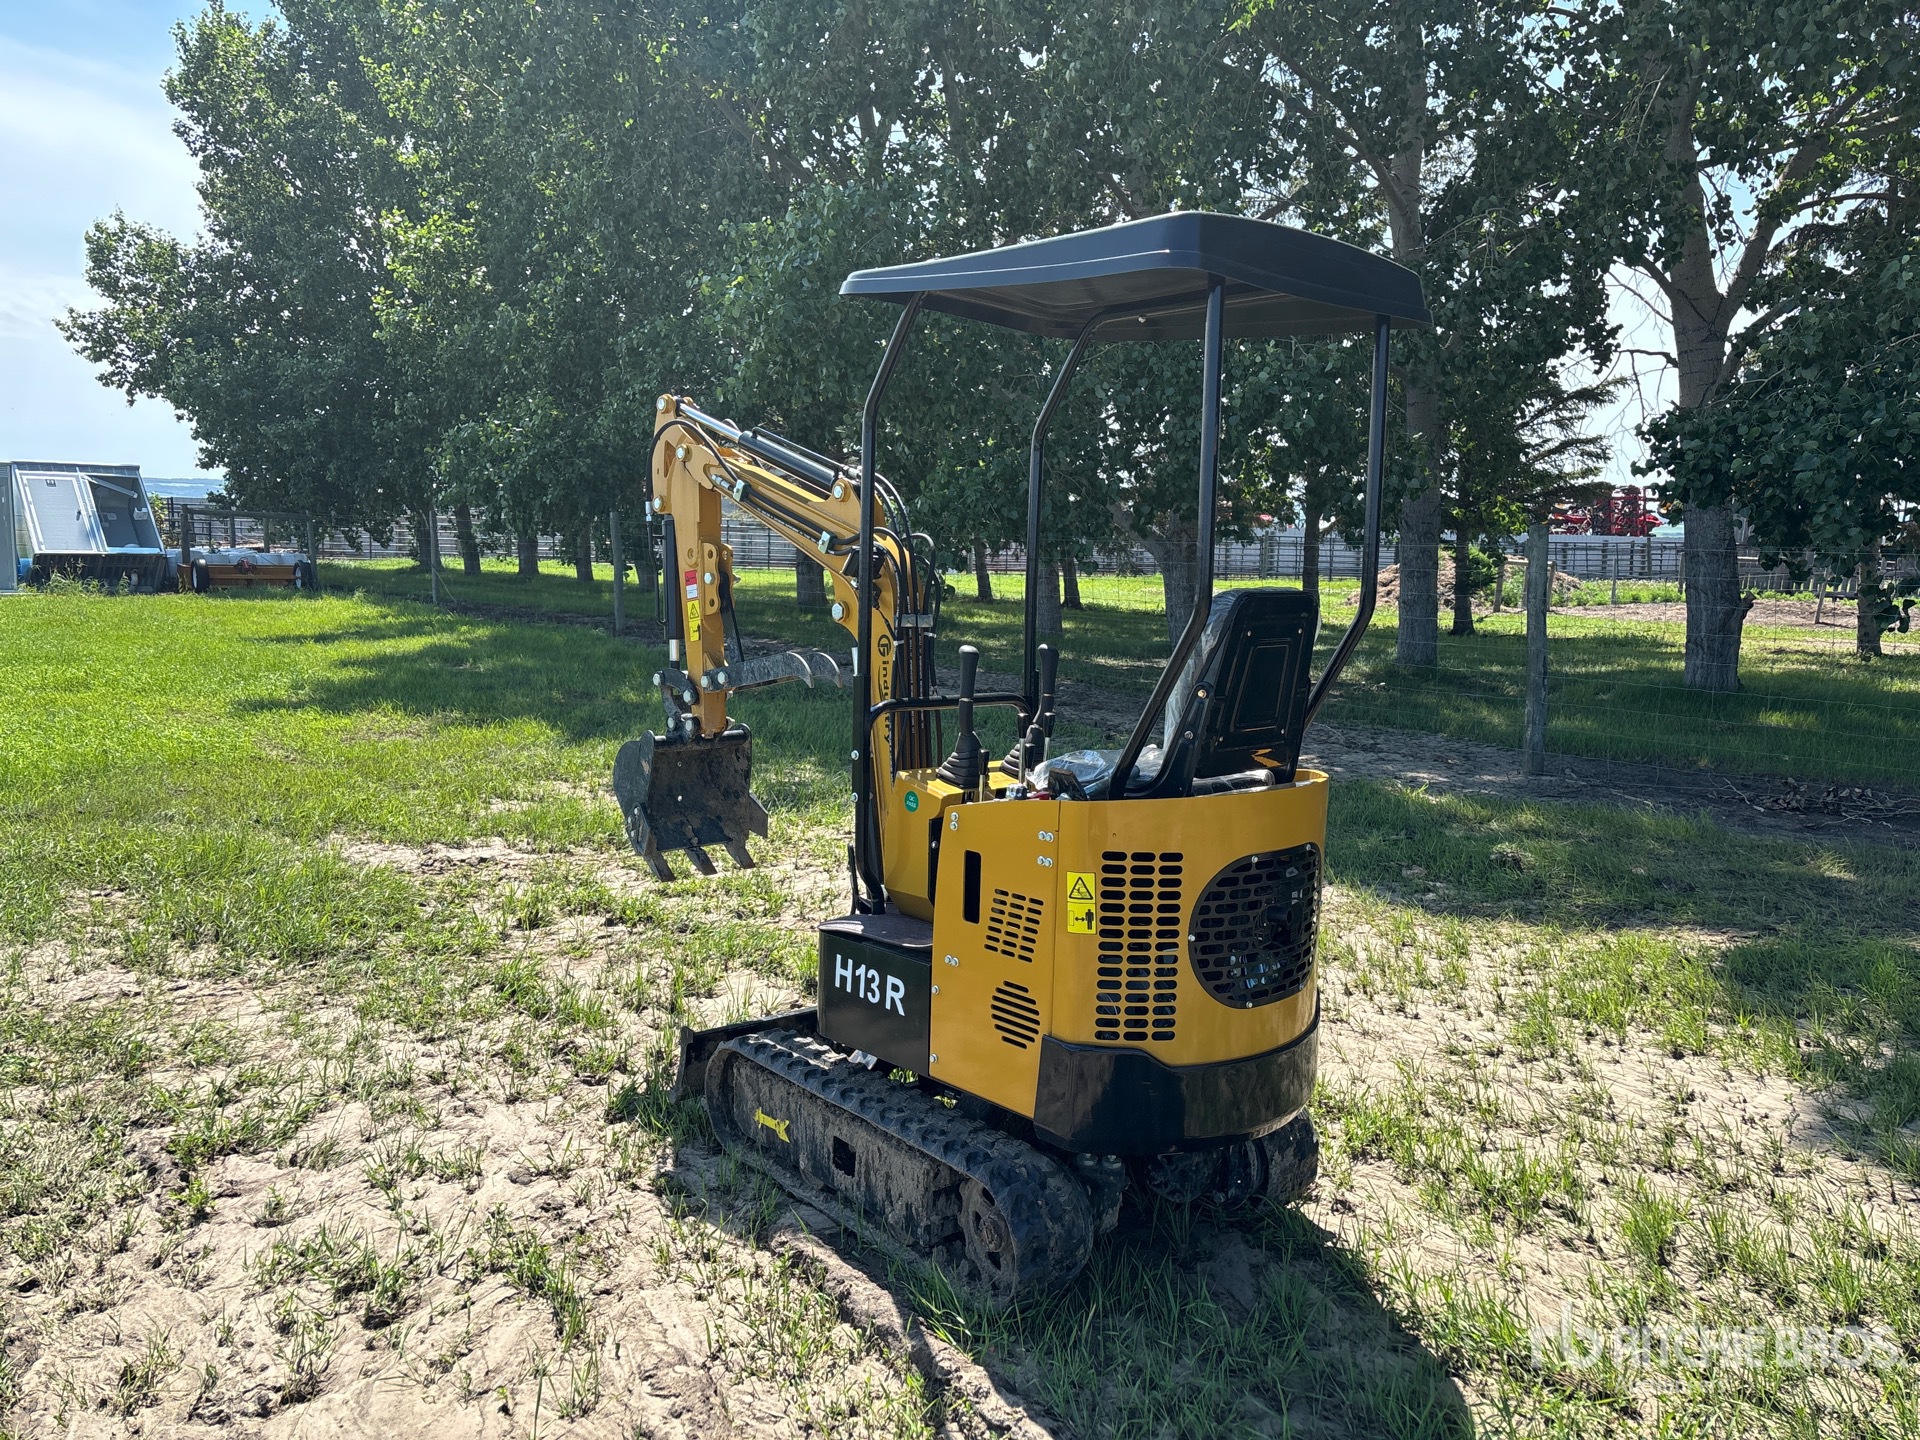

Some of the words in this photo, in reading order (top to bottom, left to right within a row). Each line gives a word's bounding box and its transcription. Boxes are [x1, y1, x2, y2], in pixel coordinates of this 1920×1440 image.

[881, 660, 890, 744] indutry
[835, 953, 880, 1004] H13
[885, 974, 906, 1017] R
